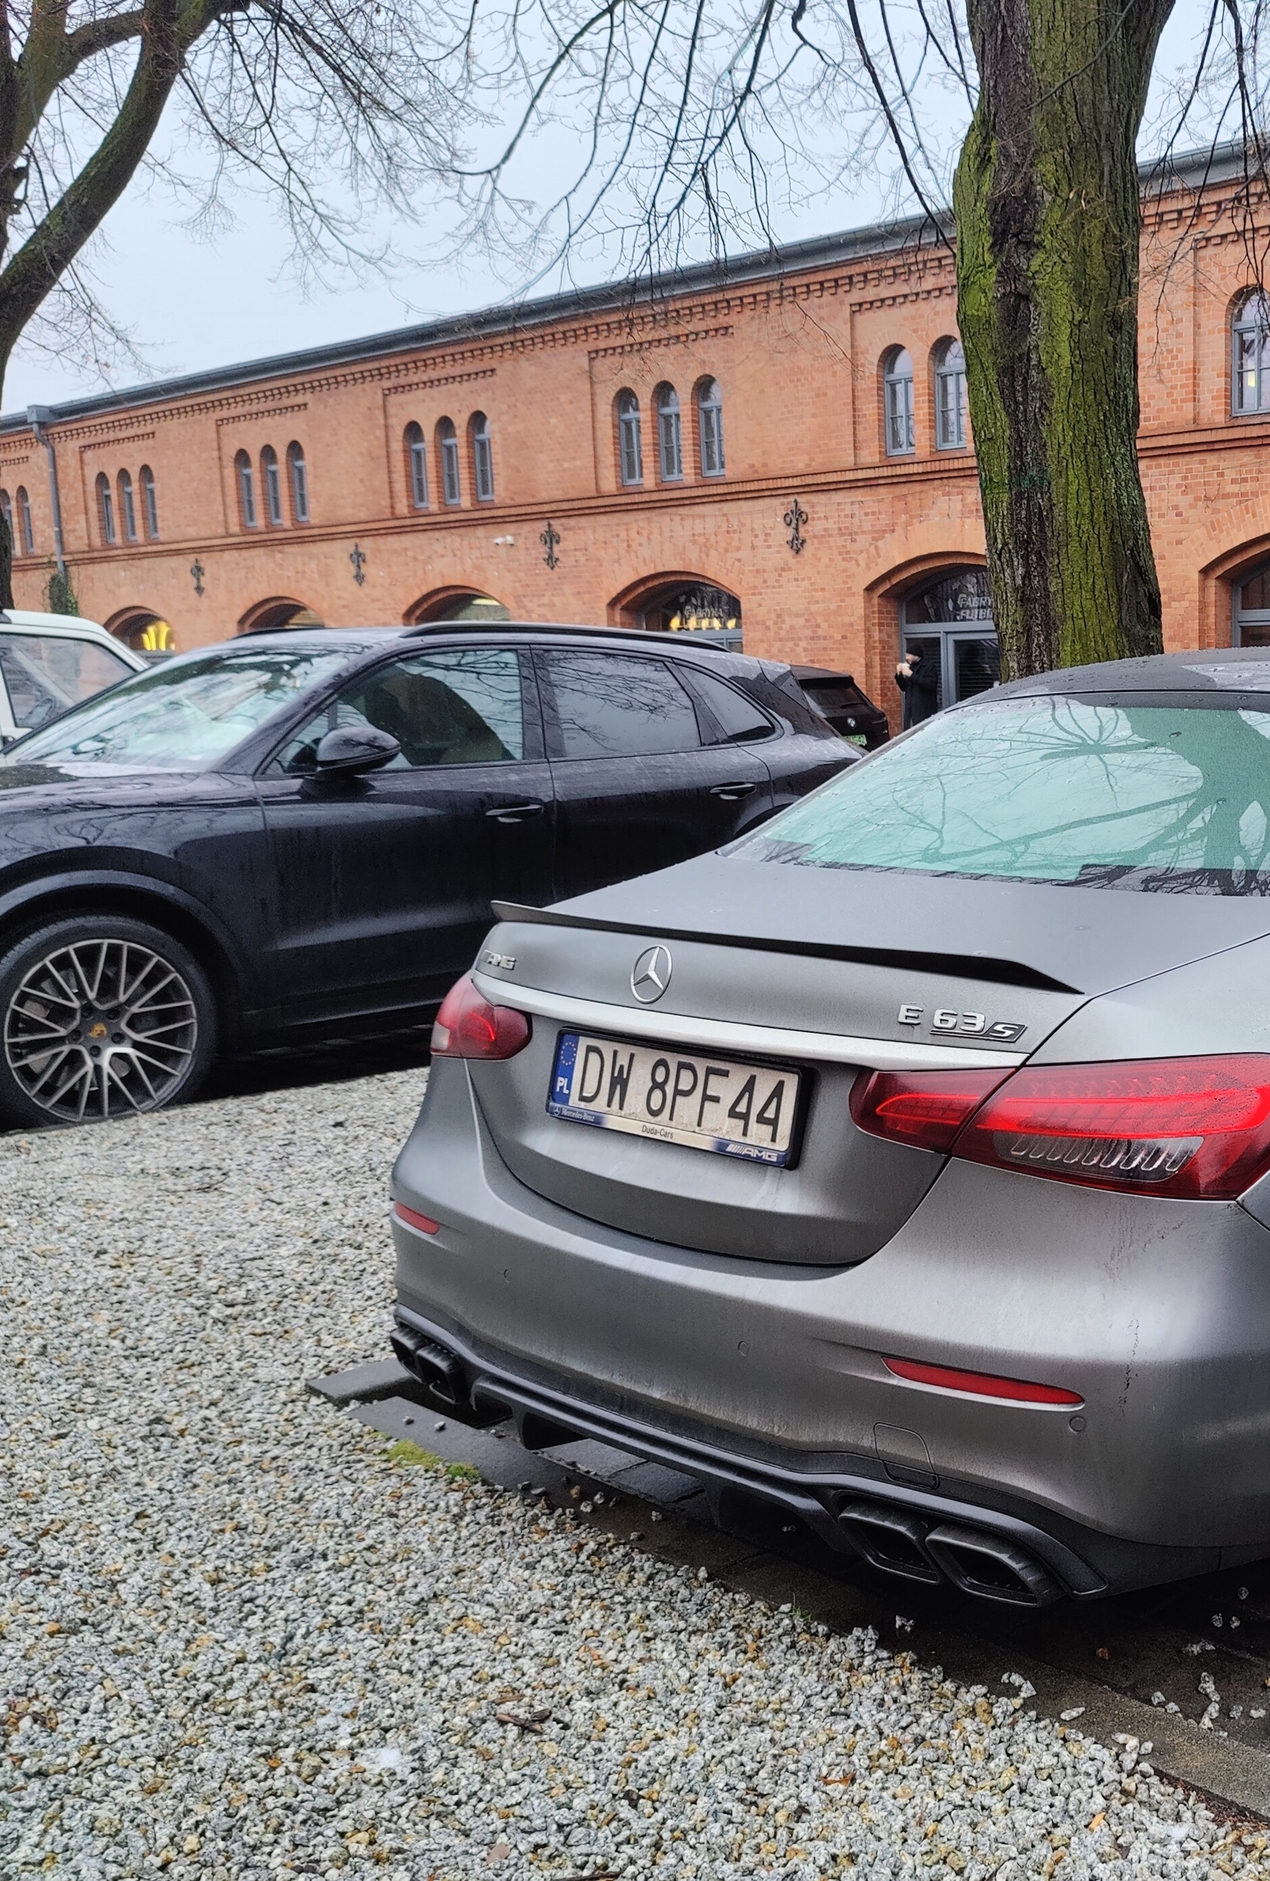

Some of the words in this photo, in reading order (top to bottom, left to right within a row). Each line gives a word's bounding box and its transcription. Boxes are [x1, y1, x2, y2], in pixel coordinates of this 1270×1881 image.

[960, 597, 994, 608] FABRY
[960, 609, 993, 620] FUTBO
[897, 1004, 923, 1026] E
[556, 1076, 570, 1095] PL
[577, 1044, 635, 1111] DW
[646, 1057, 785, 1143] 8PF44
[641, 1124, 674, 1139] Duda-Cars
[742, 1147, 778, 1162] AMG
